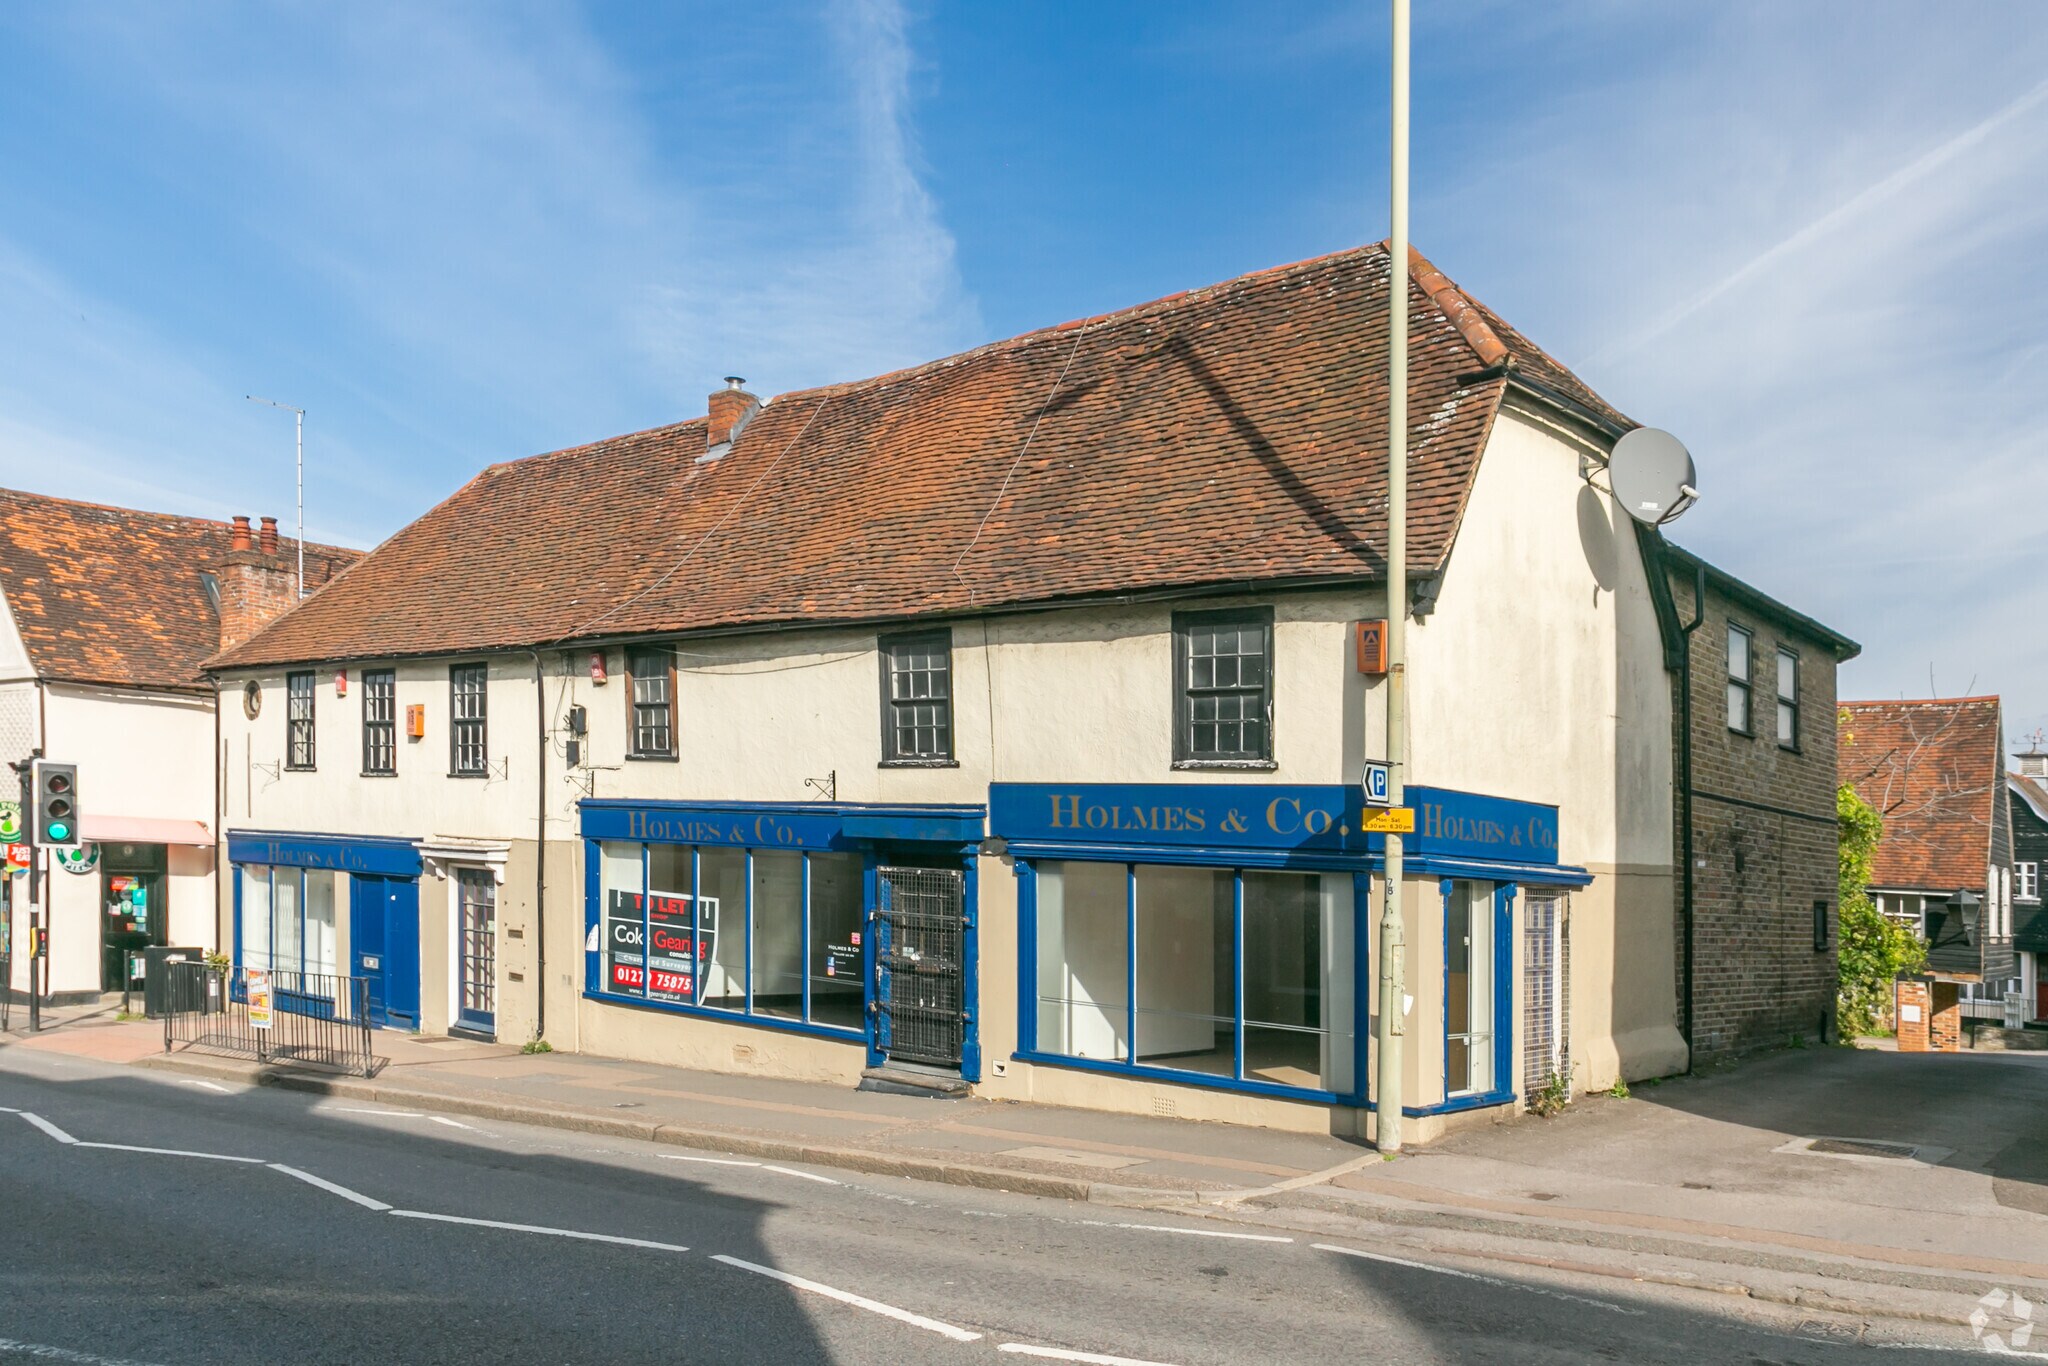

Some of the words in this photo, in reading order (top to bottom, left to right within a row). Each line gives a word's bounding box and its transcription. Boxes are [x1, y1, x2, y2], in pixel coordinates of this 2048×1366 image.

[1376, 773, 1384, 793] P
[628, 811, 721, 841] HOLMES
[729, 824, 744, 843] &
[1048, 795, 1205, 831] HOLMES
[1220, 808, 1249, 833] &
[1423, 803, 1505, 844] HOLMES
[1510, 824, 1521, 847] &
[268, 842, 321, 865] HOLMES
[657, 897, 687, 915] LET
[614, 924, 650, 945] Cok
[654, 930, 707, 960] Gearig
[657, 973, 693, 991] 75875
